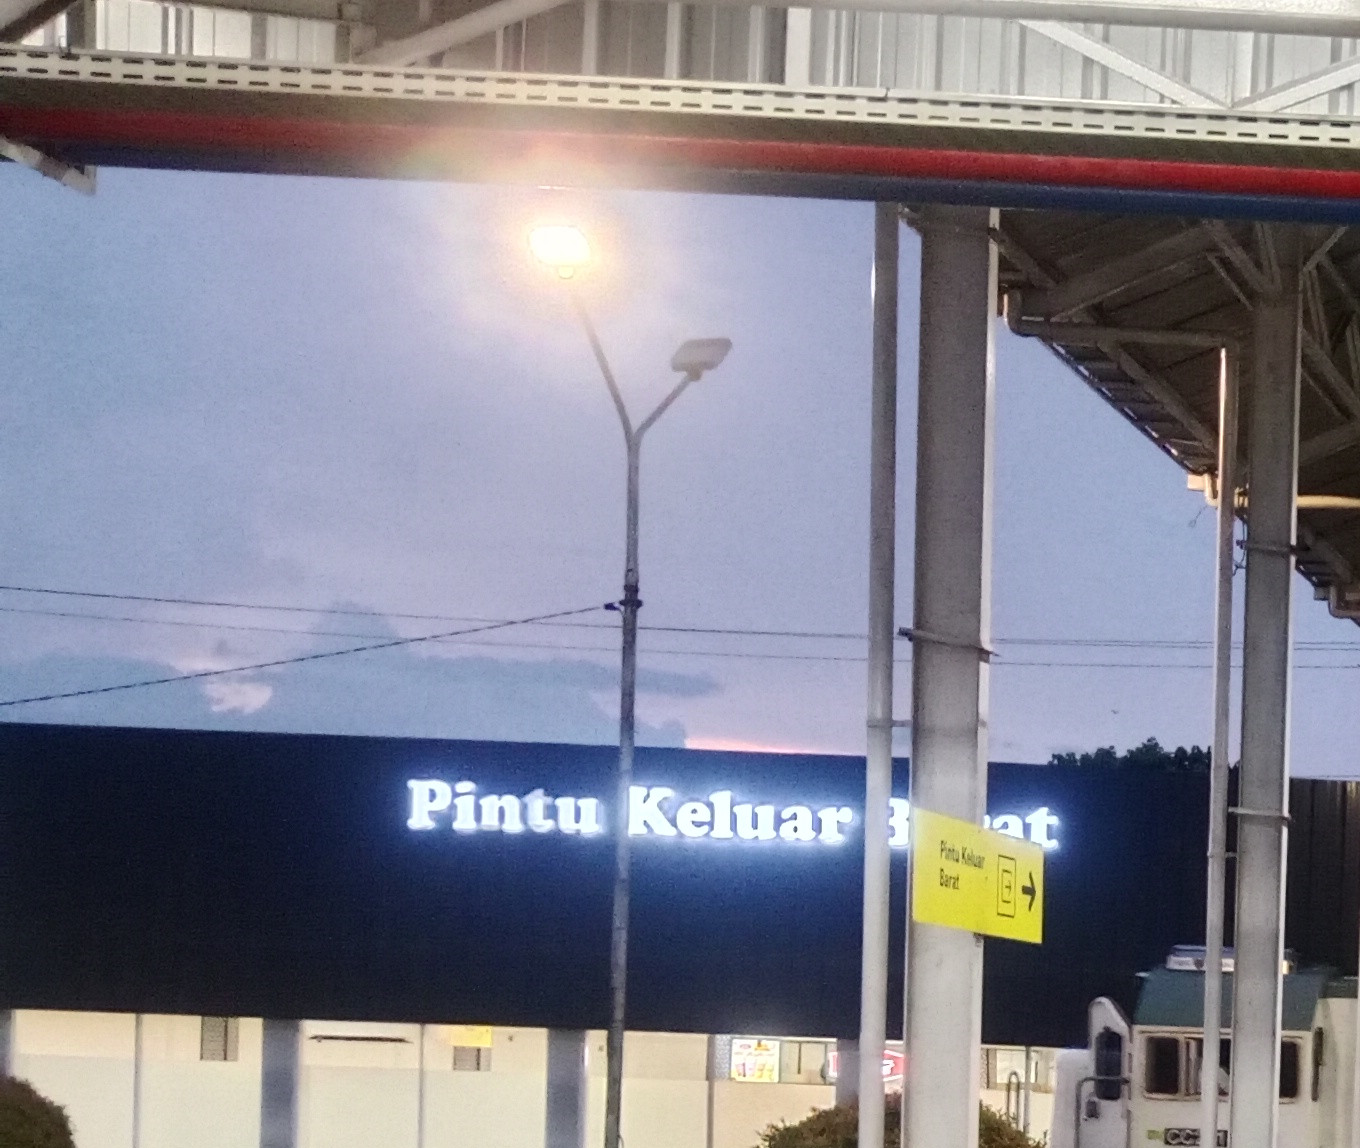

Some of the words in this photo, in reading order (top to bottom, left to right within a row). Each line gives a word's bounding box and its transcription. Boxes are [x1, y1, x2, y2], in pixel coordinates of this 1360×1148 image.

[406, 778, 604, 837] Pintu
[628, 783, 853, 843] Keluar
[940, 867, 960, 890] Barat
